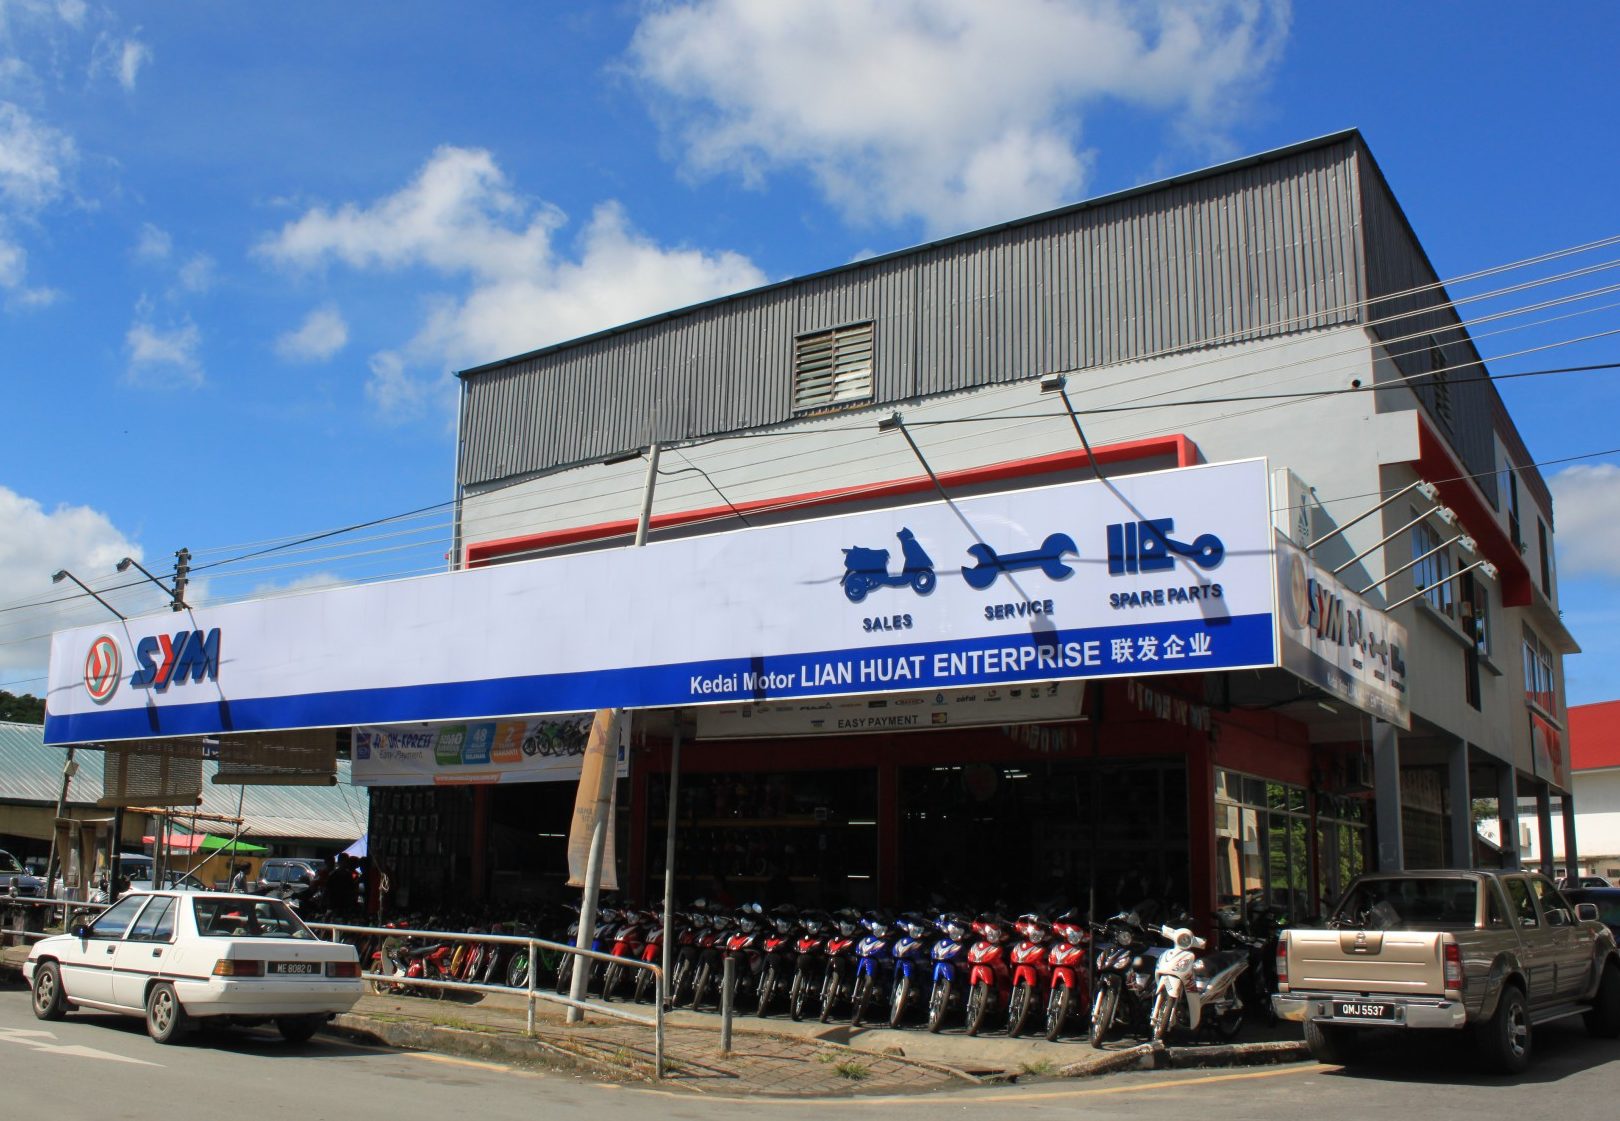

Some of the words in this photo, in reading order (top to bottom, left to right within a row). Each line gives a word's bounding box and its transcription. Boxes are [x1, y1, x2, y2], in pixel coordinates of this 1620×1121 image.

[1110, 588, 1165, 608] SPARE
[1167, 582, 1224, 604] PARTS
[862, 613, 913, 632] SALES
[984, 599, 1054, 621] SERVICE
[1307, 578, 1344, 646] SYM
[130, 628, 221, 688] SYM
[1110, 632, 1212, 664] 联发企业
[690, 673, 738, 695] Kedai
[743, 671, 796, 691] Motor
[800, 661, 852, 687] LIAN
[860, 655, 925, 683] HUAT
[933, 641, 1101, 678] ENTERPRISE
[838, 718, 865, 729] EASY
[868, 714, 918, 727] PAYMENT
[1342, 1003, 1360, 1015] QMJ
[1361, 1004, 1384, 1016] 5537
